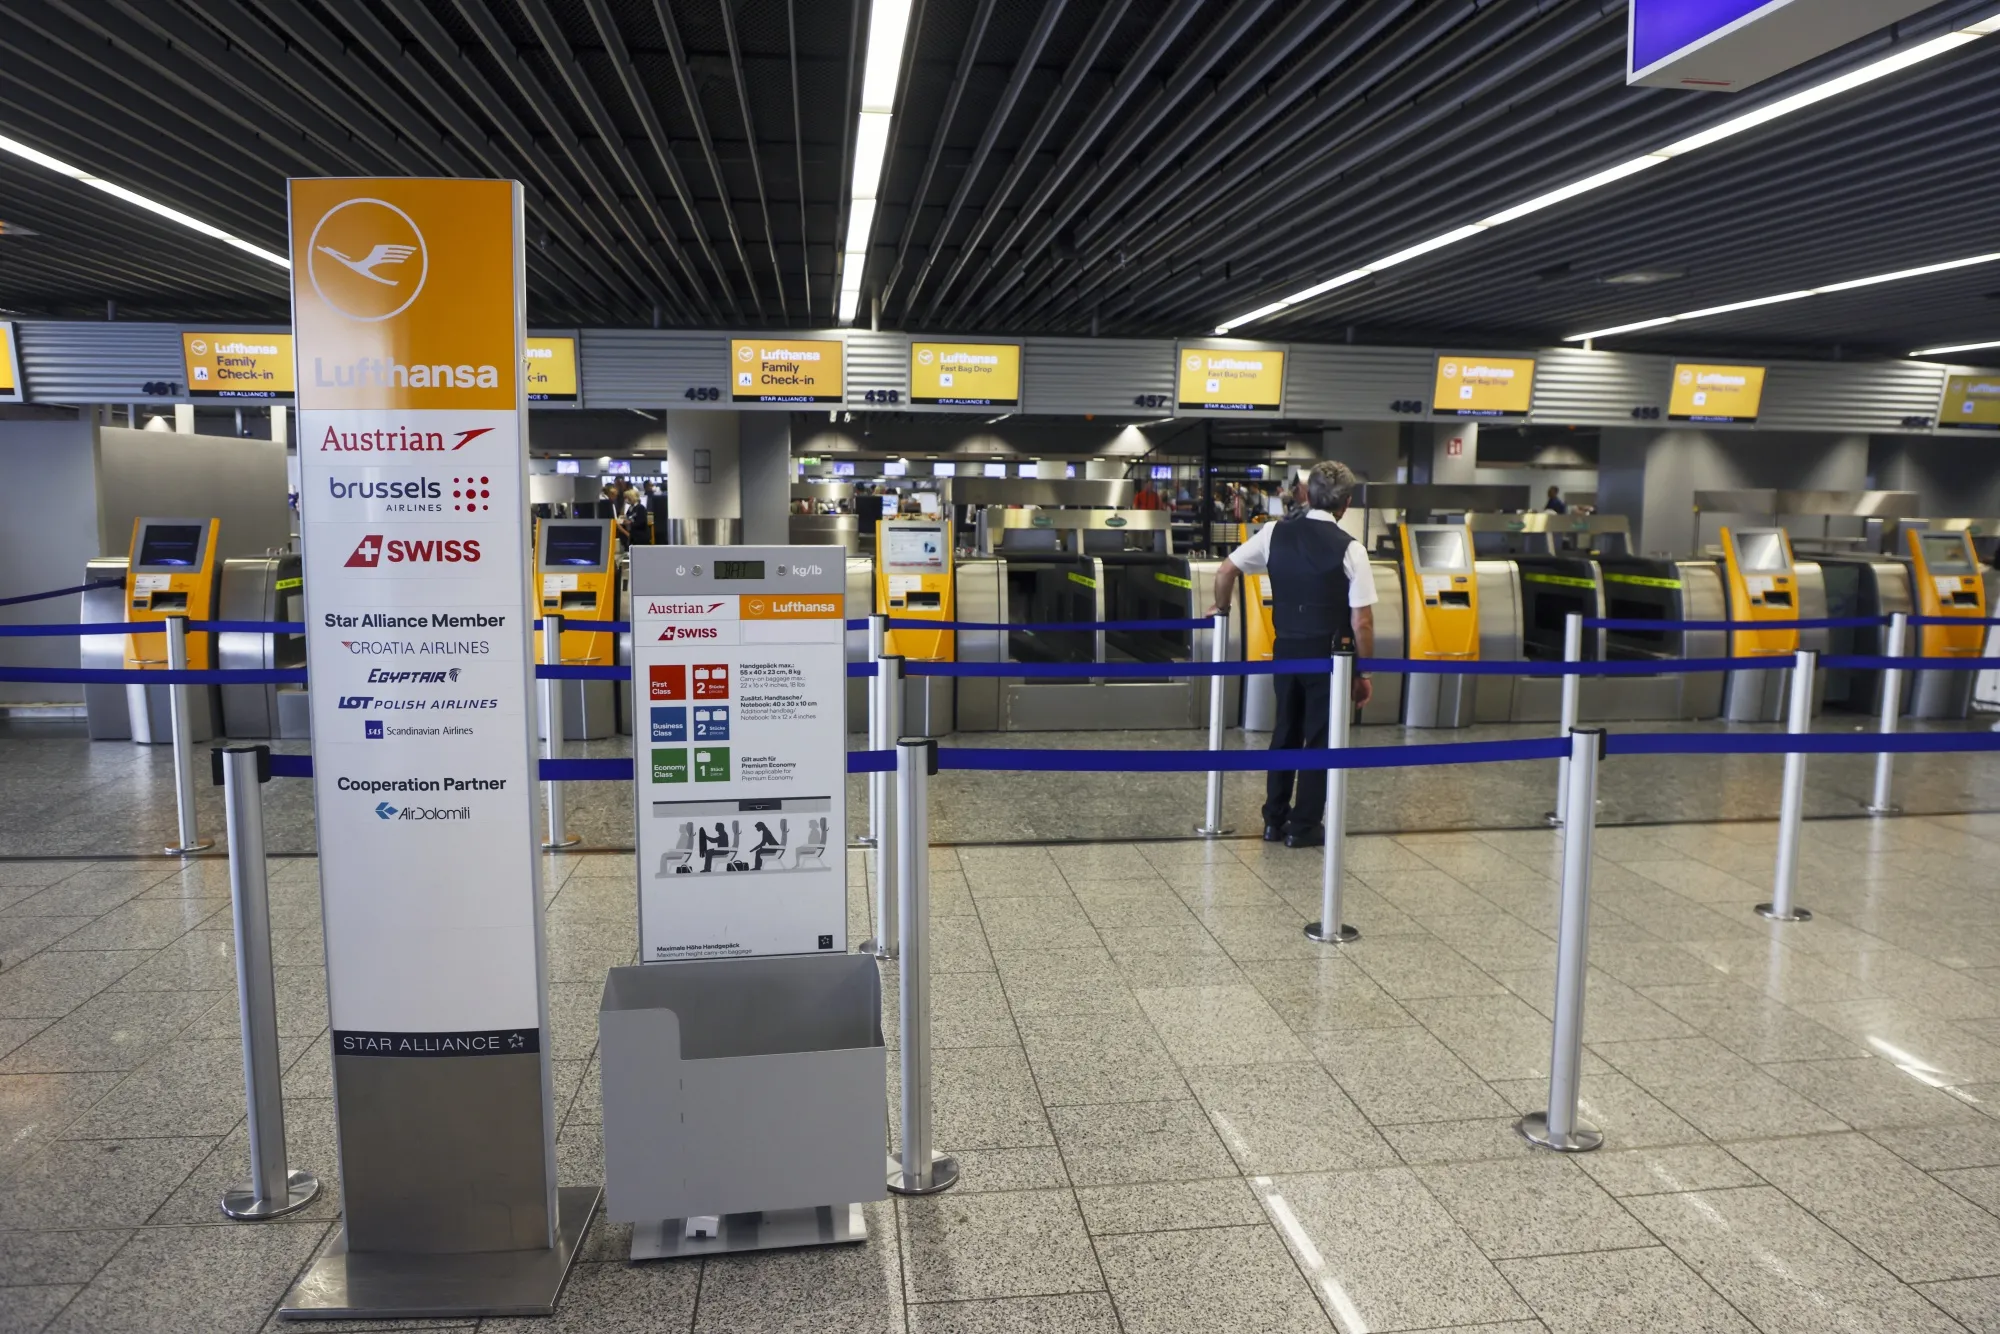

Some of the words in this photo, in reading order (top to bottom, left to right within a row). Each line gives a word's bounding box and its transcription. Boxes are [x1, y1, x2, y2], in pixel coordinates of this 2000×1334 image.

[214, 342, 278, 354] Lufthansa
[760, 349, 820, 361] Lufthansa
[940, 352, 998, 364] Lufthansa
[217, 356, 256, 368] Family
[762, 362, 799, 373] Family
[217, 368, 274, 379] Check-in
[315, 357, 498, 388] Lufthansa
[761, 374, 814, 385] Check-in
[685, 387, 720, 401] 459
[865, 389, 899, 403] 458
[1135, 394, 1167, 408] 457
[321, 425, 445, 451] Austrian
[330, 477, 441, 499] brussels
[386, 504, 442, 512] AIRLINES
[387, 539, 481, 563] SWISS
[792, 565, 822, 577] kg/lb
[648, 602, 704, 614] Austrian
[772, 601, 835, 613] Lufthansa
[324, 613, 359, 628] Star
[361, 613, 428, 628] Alliance
[432, 613, 505, 628] Member
[677, 628, 717, 638] SWISS
[350, 641, 415, 655] CROATIA
[419, 640, 490, 654] AIRLINES
[696, 682, 706, 694] 2
[338, 696, 374, 709] LOT
[374, 700, 425, 709] POLISH
[430, 699, 498, 709] AIRLINES
[386, 726, 440, 736] Scandinavian
[443, 726, 473, 735] Airlines
[697, 724, 707, 735] 2
[700, 765, 706, 776] 1
[337, 776, 440, 794] Cooperation
[444, 777, 506, 791] Partner
[343, 1036, 392, 1051] STAR
[399, 1036, 500, 1051] ALLIANCE
